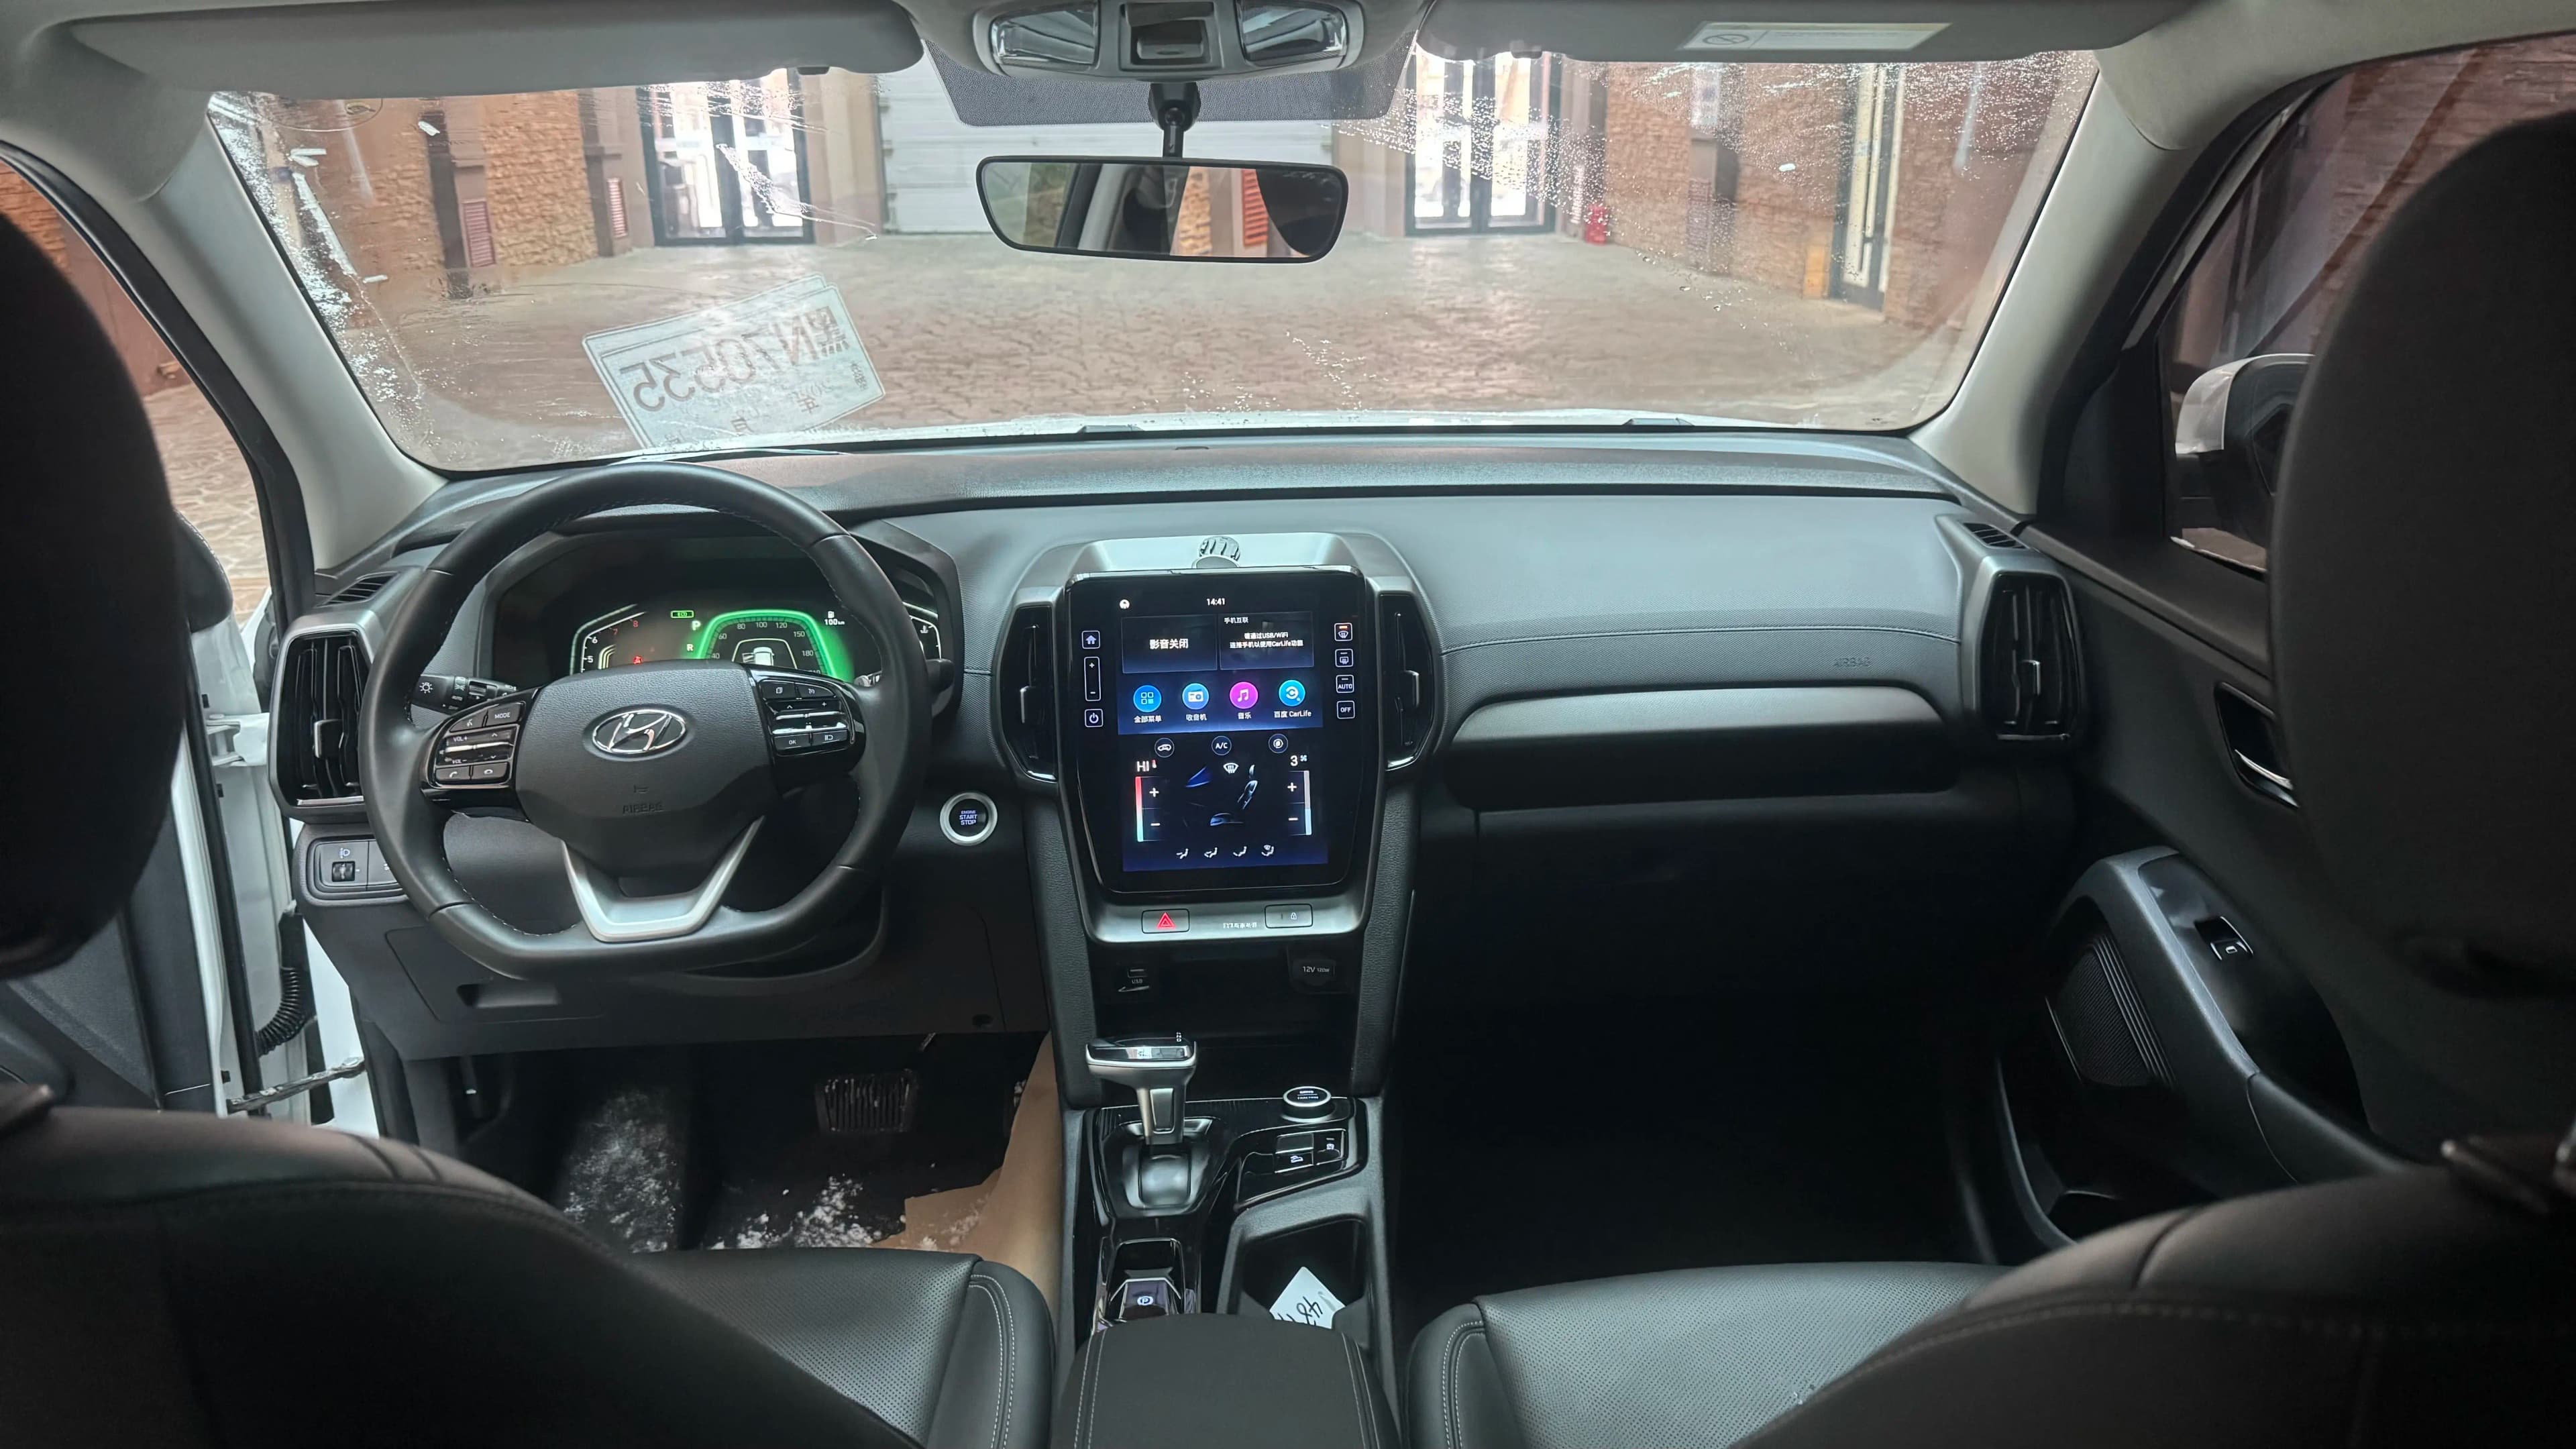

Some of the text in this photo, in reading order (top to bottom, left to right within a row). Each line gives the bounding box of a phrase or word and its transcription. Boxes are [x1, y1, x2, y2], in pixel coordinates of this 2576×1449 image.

[1206, 598, 1226, 606] 14:41
[692, 620, 701, 631] P
[591, 636, 598, 644] 6
[1149, 638, 1189, 649] 影音关闭
[686, 643, 694, 651] R
[587, 655, 594, 663] 5
[1186, 713, 1207, 721] 收音机
[1289, 710, 1312, 718] CarLife
[1134, 715, 1162, 723] 全部菜单
[1216, 742, 1228, 750] A/C
[1290, 755, 1298, 766] 3
[1136, 760, 1150, 772] HI
